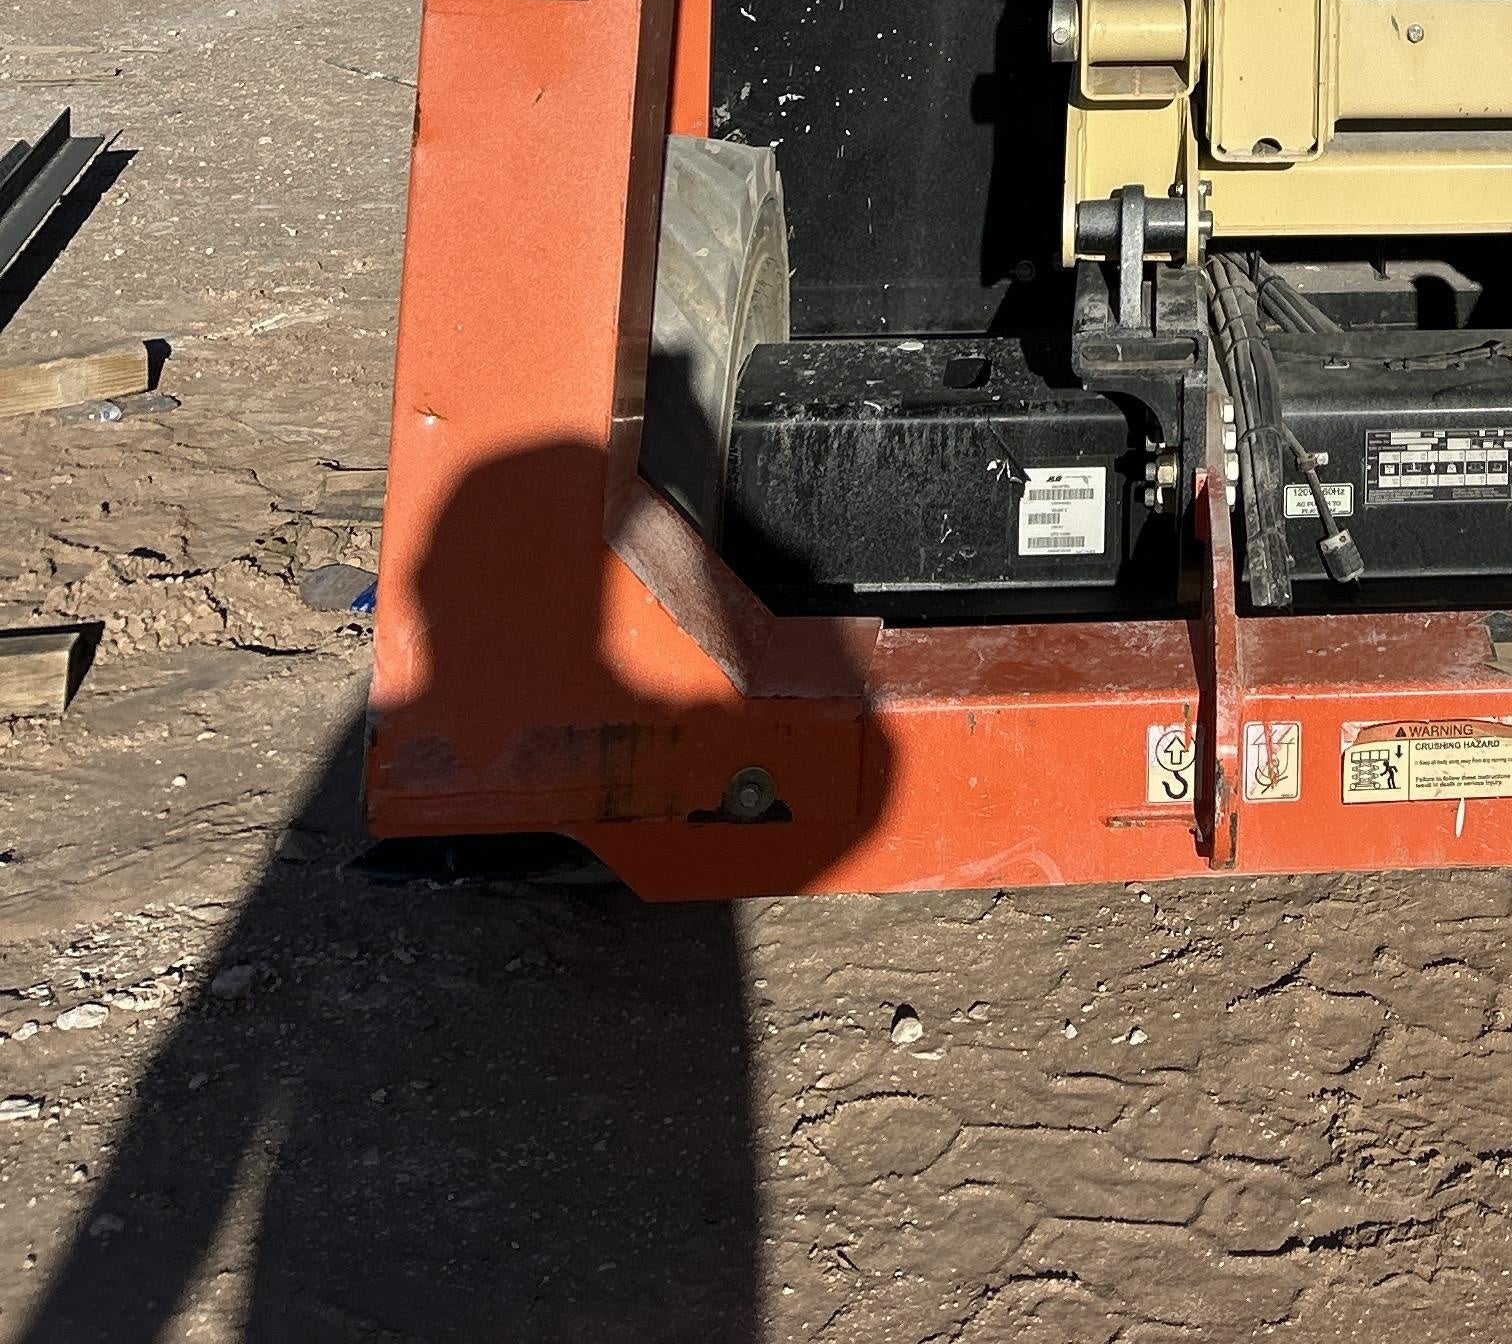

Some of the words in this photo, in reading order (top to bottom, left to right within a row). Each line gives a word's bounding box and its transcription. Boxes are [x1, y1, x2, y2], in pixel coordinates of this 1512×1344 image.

[1408, 724, 1474, 738] WARNING
[1414, 741, 1462, 751] CRUSHING
[1463, 739, 1500, 749] HAZARD
